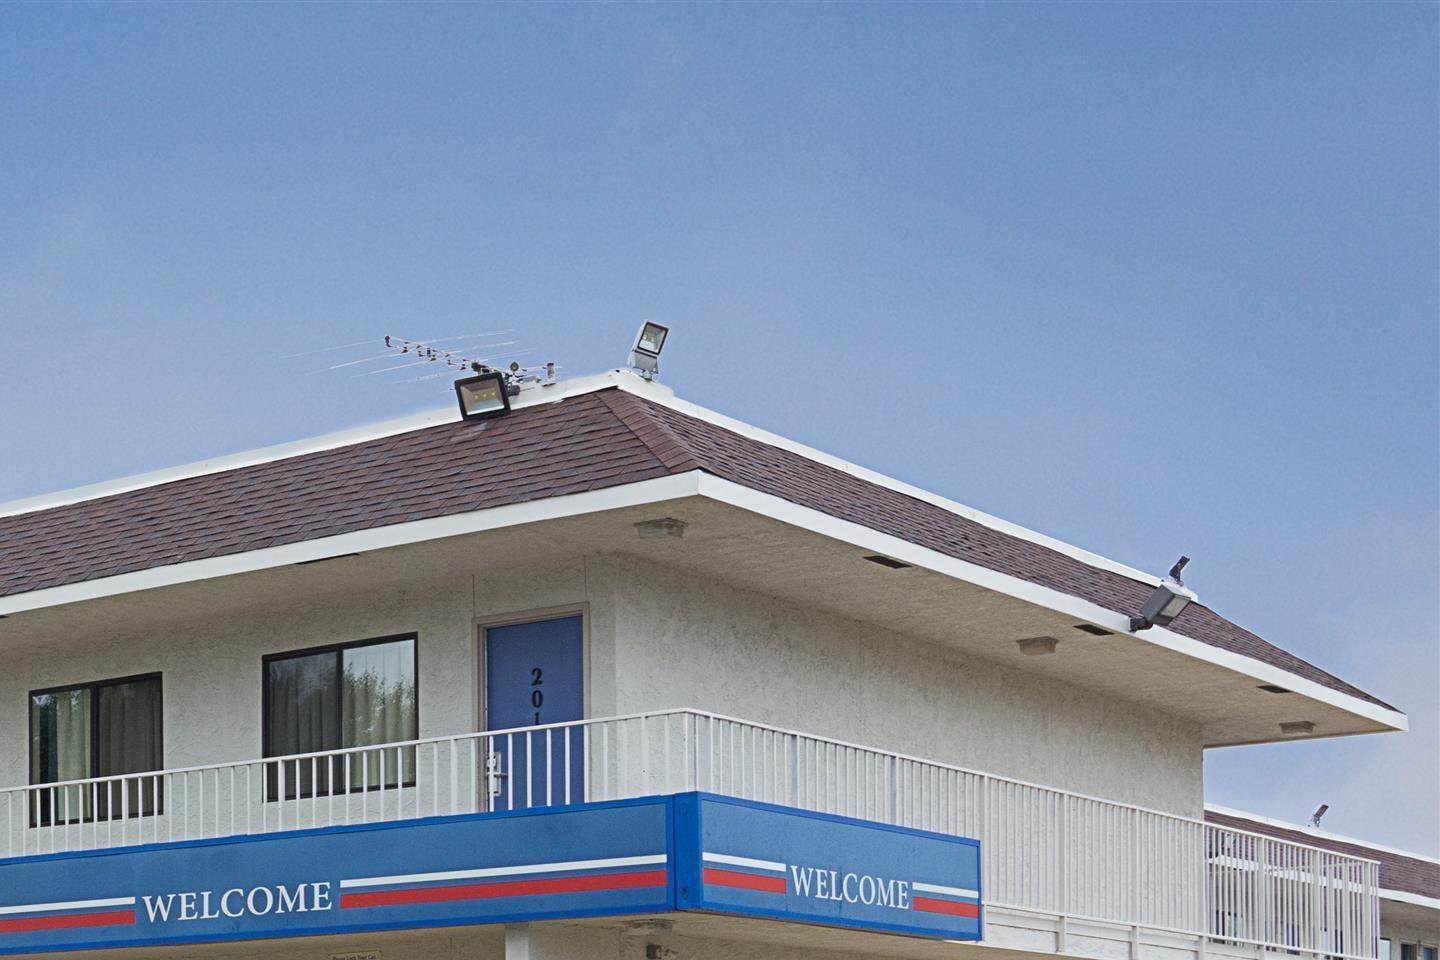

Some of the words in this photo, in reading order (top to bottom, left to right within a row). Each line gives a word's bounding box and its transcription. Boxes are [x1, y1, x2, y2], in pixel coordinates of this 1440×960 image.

[530, 667, 544, 725] 201
[140, 881, 333, 923] WELCOME
[789, 864, 910, 910] WELCOME
